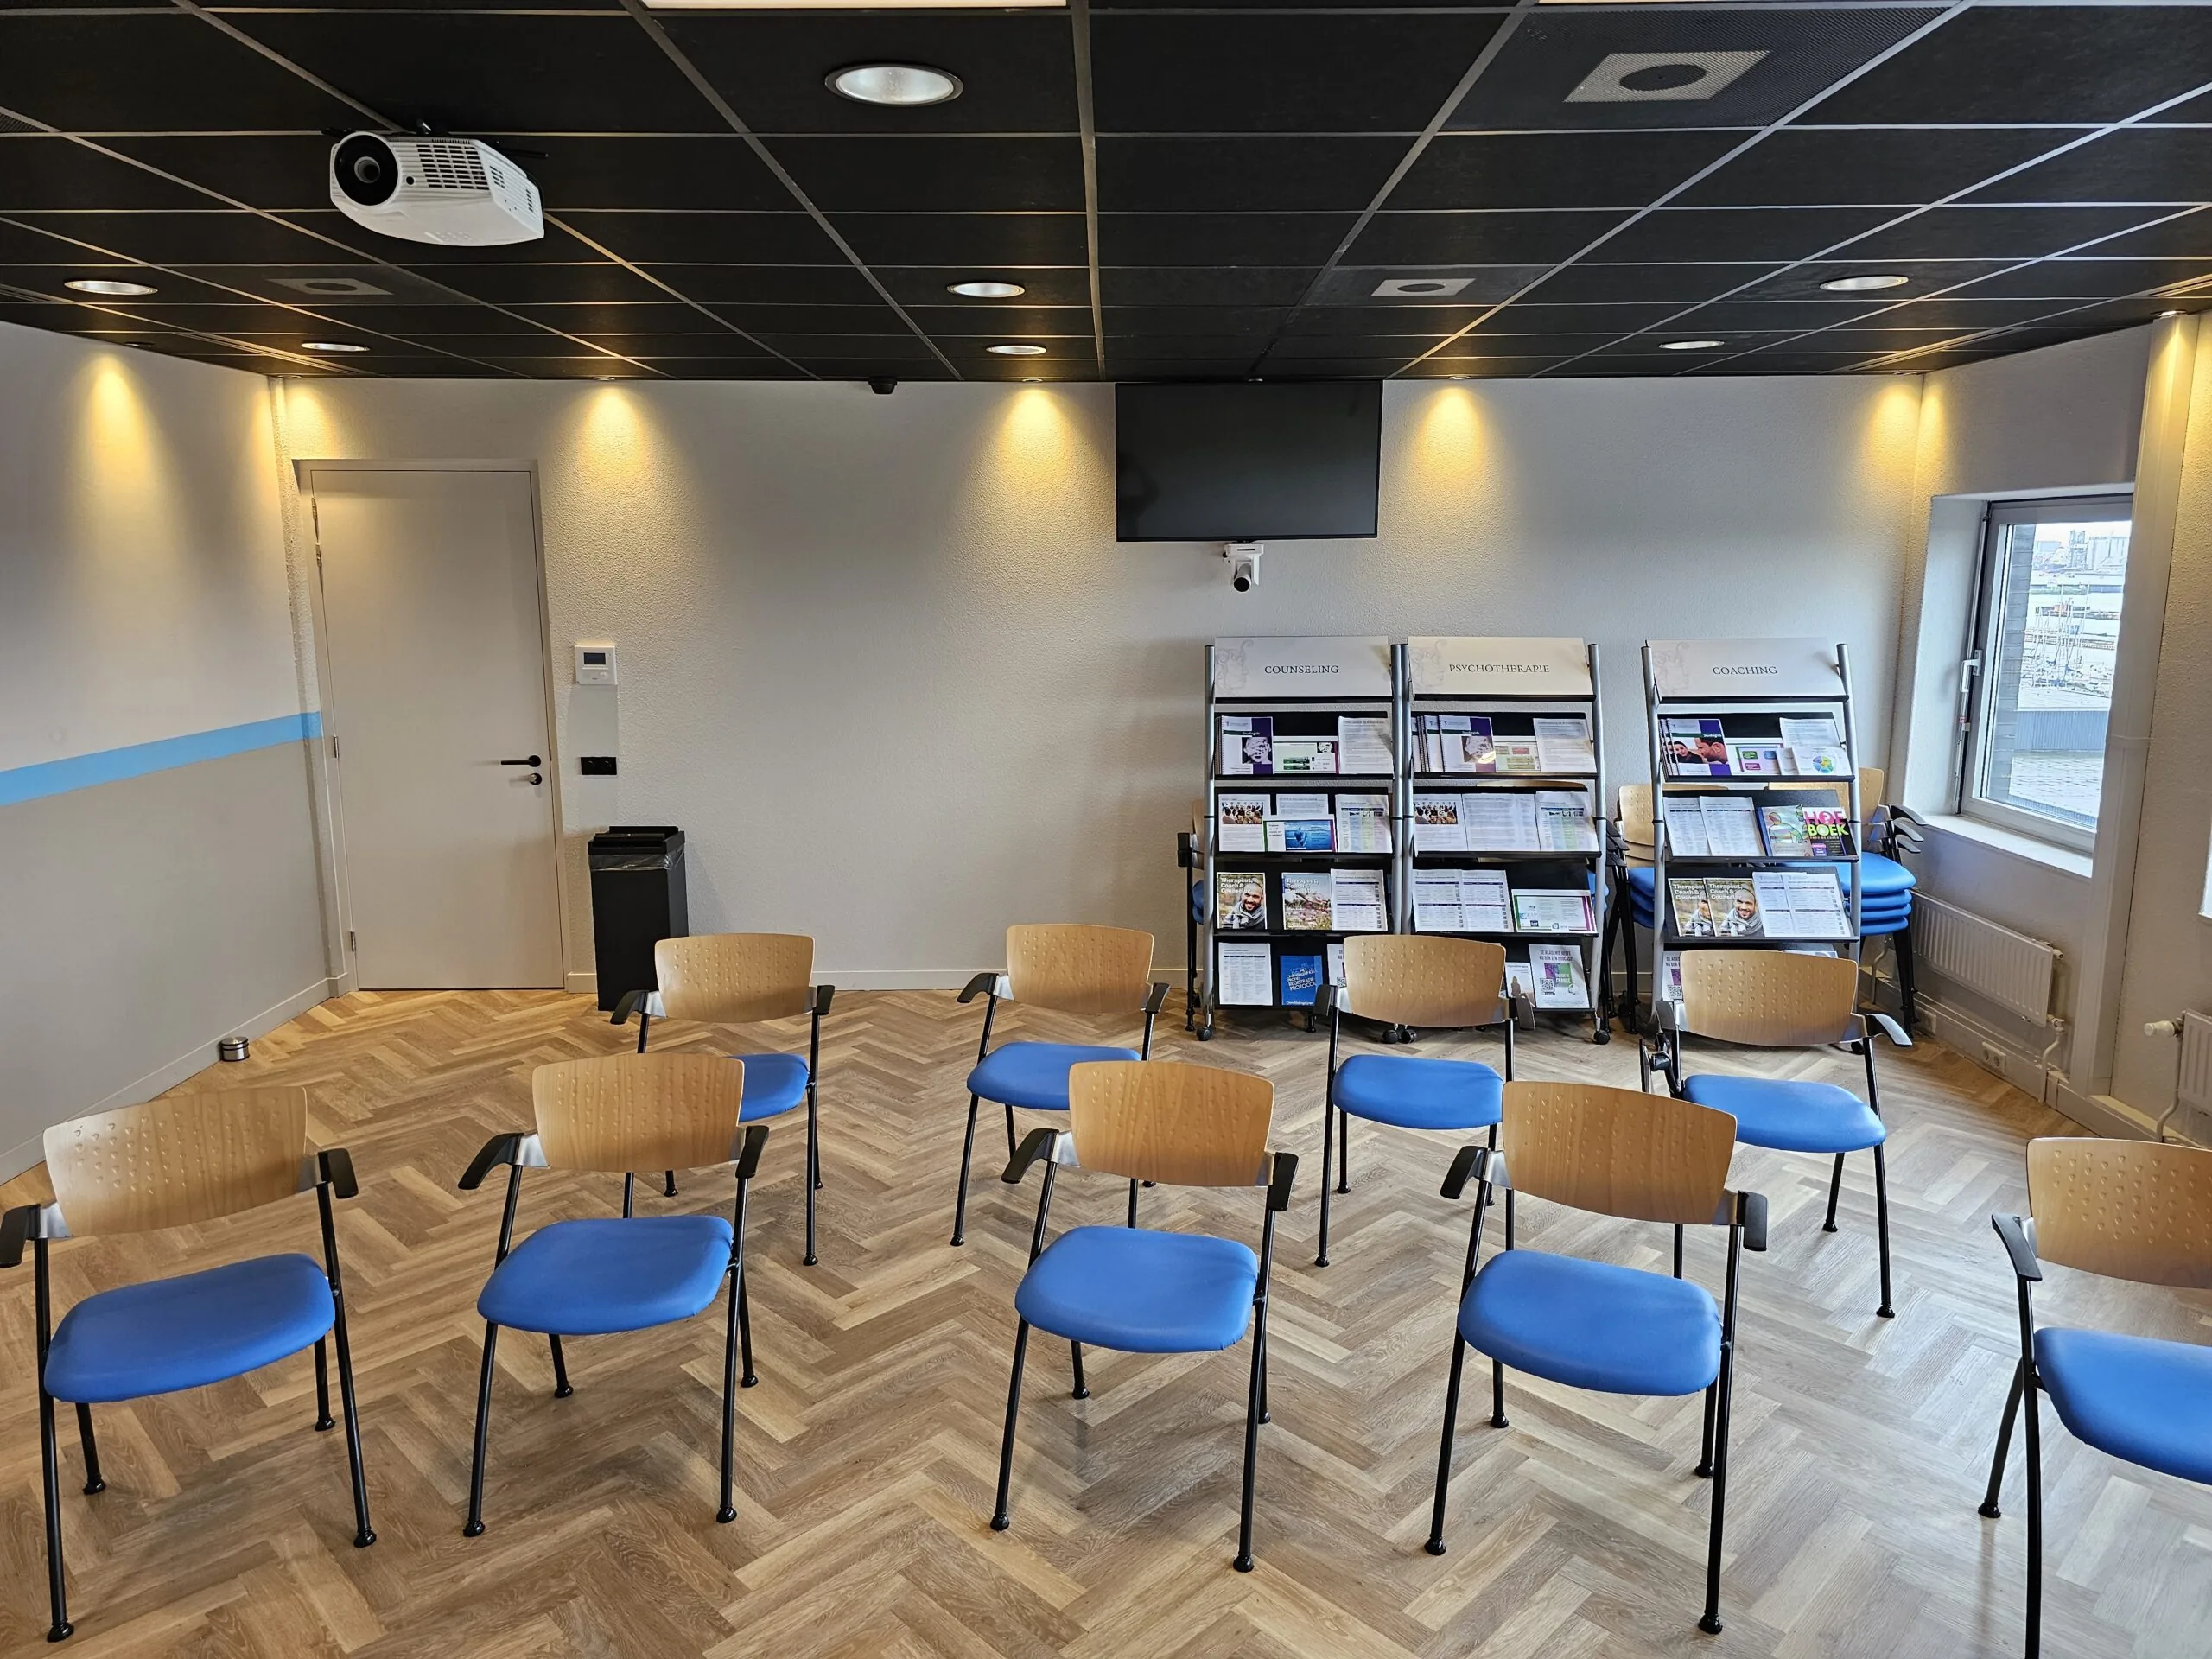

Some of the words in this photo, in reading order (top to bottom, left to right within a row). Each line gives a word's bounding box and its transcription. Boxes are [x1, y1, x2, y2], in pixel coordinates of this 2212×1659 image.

[1264, 664, 1339, 674] COUNSELING
[1449, 664, 1550, 673] PSYCHOTHERAPIE
[1713, 665, 1777, 675] COACHING
[1804, 811, 1845, 825] HOE
[1808, 823, 1849, 836] BOEK
